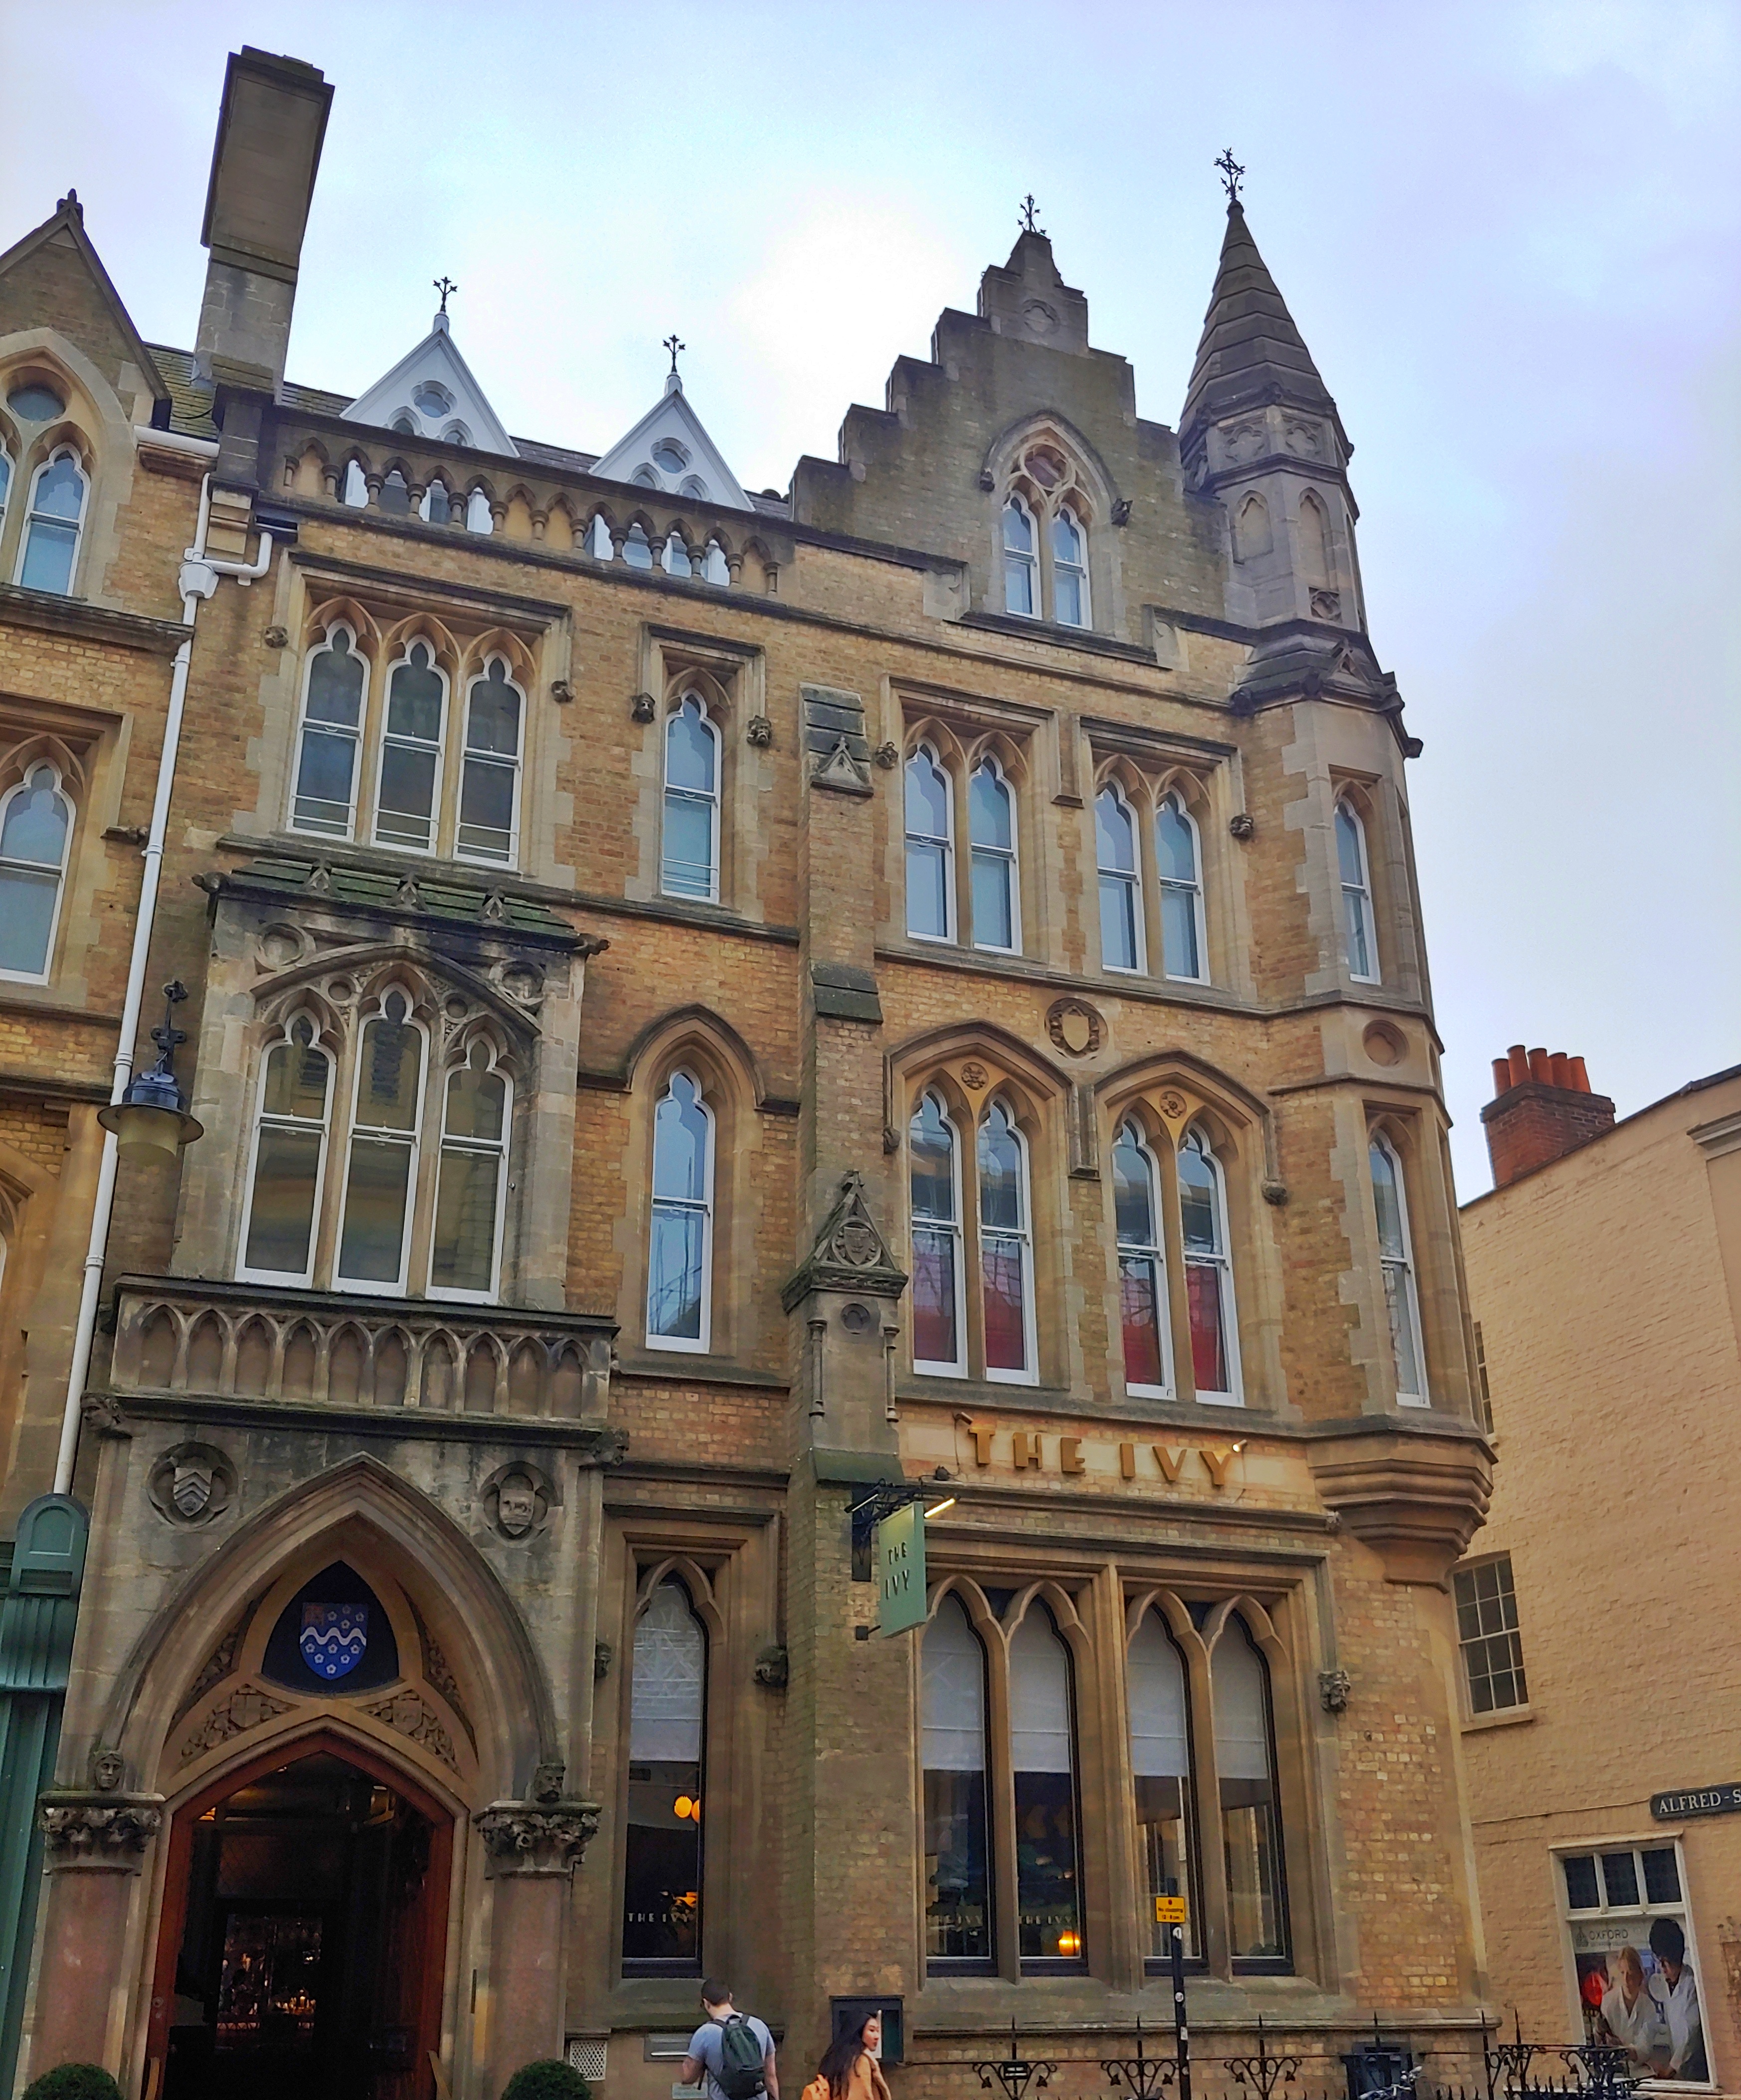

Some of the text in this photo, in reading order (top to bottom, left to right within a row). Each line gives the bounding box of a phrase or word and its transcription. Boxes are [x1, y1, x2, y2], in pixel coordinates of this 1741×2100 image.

[968, 1428, 1231, 1486] THE IVY
[887, 1541, 907, 1566] THE
[885, 1569, 910, 1600] IVY
[1659, 1791, 1722, 1814] ALFRED
[628, 1913, 655, 1923] THE
[1588, 1928, 1628, 1940] OXFORD
